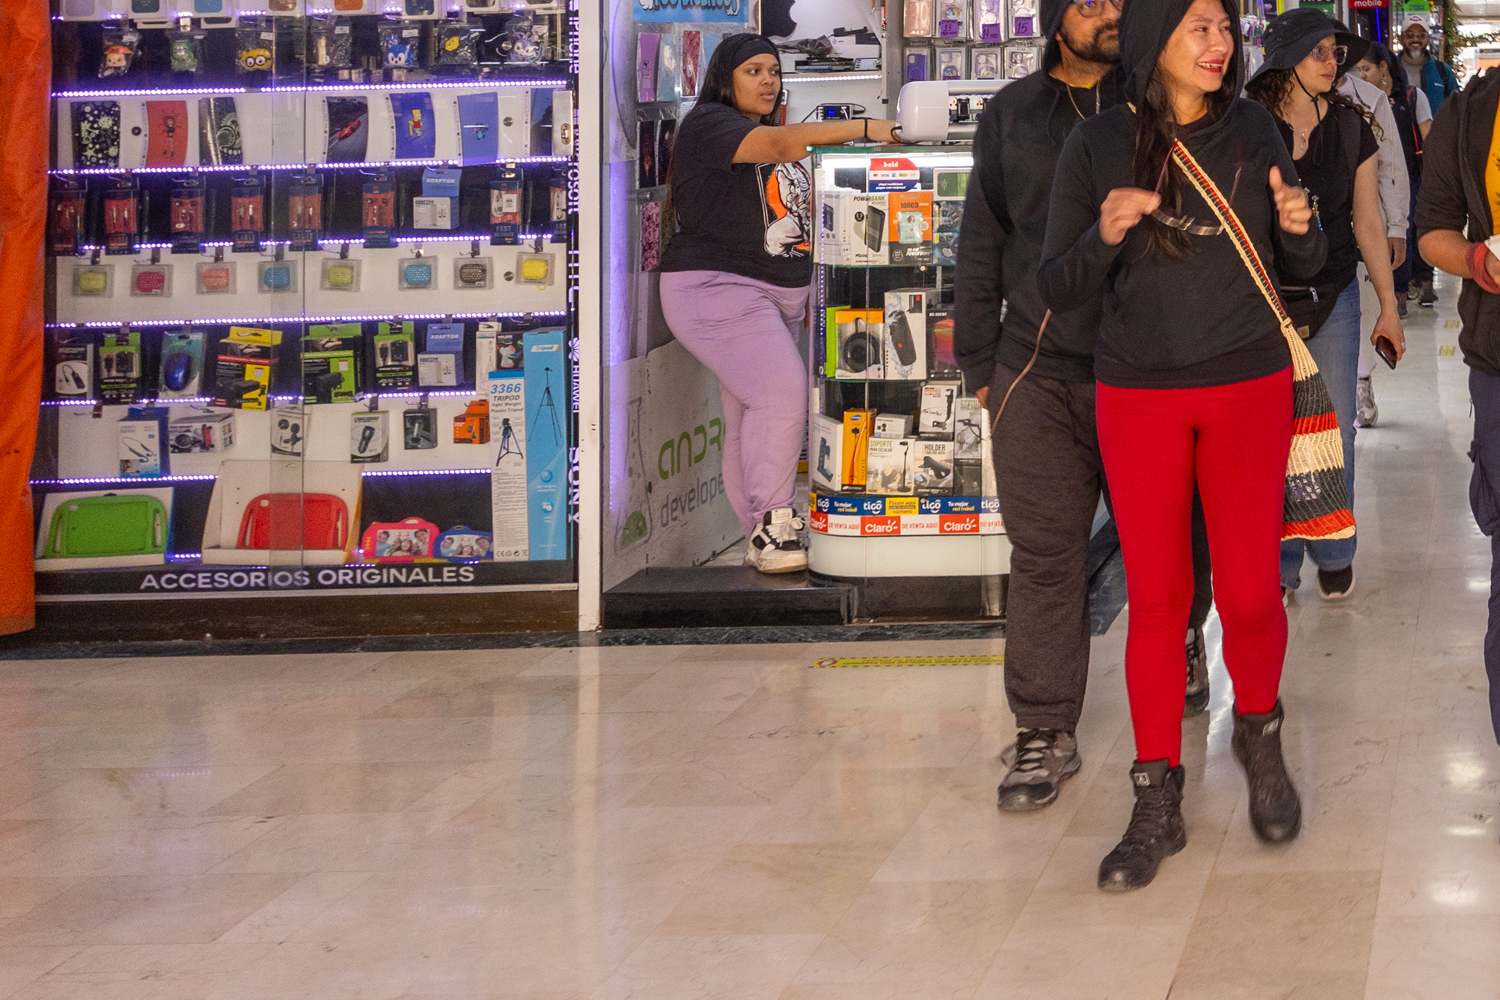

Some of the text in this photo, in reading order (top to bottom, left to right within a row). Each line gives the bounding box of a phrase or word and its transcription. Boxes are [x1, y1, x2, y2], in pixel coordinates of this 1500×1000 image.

[567, 16, 580, 75] iPhone
[567, 128, 580, 215] crosoft
[490, 383, 522, 394] 3366
[493, 394, 521, 402] TRIPOD
[869, 440, 893, 448] SOPORTE
[924, 443, 946, 451] HOLDER
[660, 472, 725, 529] develope
[864, 521, 895, 533] Claro
[943, 521, 974, 532] Claro
[139, 566, 476, 591] ACCESORIOS ORIGINALES
